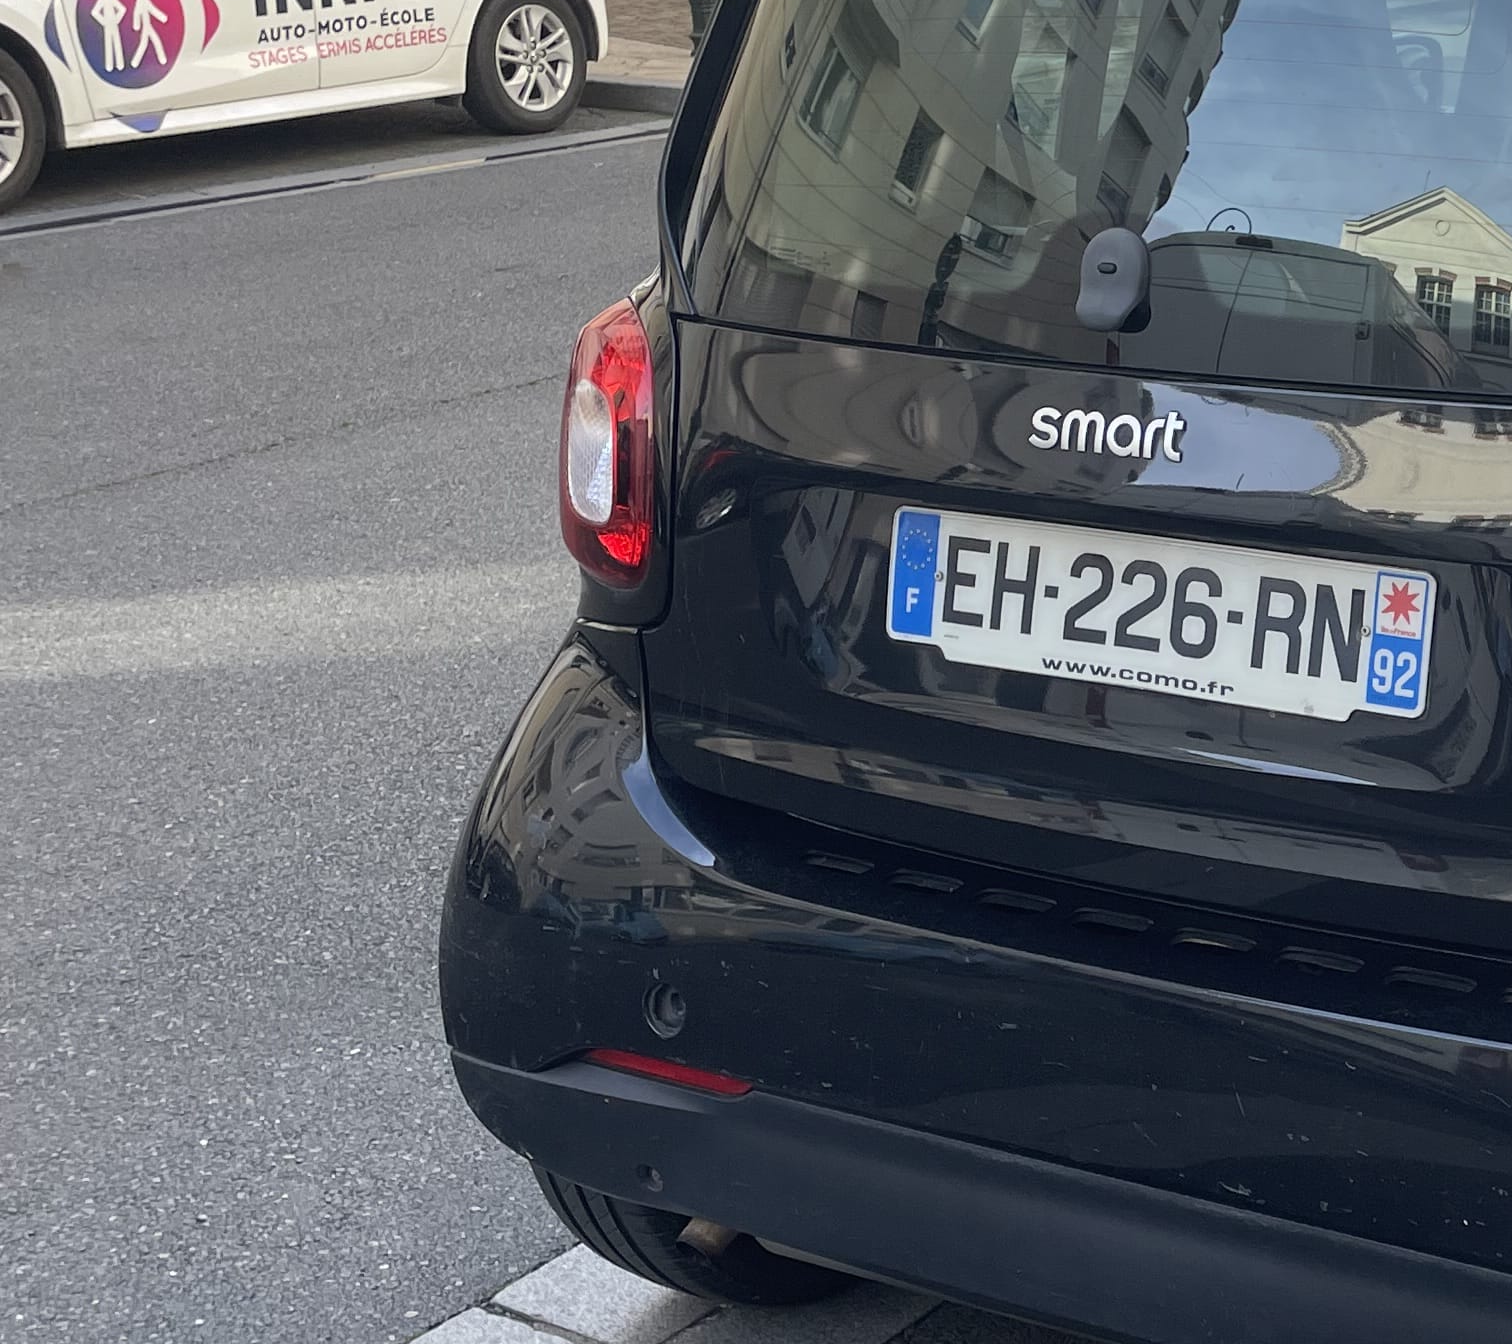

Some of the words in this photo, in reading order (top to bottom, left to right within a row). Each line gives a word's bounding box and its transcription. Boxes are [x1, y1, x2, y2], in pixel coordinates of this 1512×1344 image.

[248, 45, 308, 69] STAGES
[364, 23, 448, 52] ACCÉLÉRÉS
[257, 6, 436, 45] AUTO-MOTO-ÉCOLE
[1028, 406, 1185, 463] smart
[905, 587, 921, 613] F
[942, 535, 1366, 683] EH-226-RN
[1041, 657, 1234, 697] www.como.fr
[1372, 648, 1417, 698] 92
